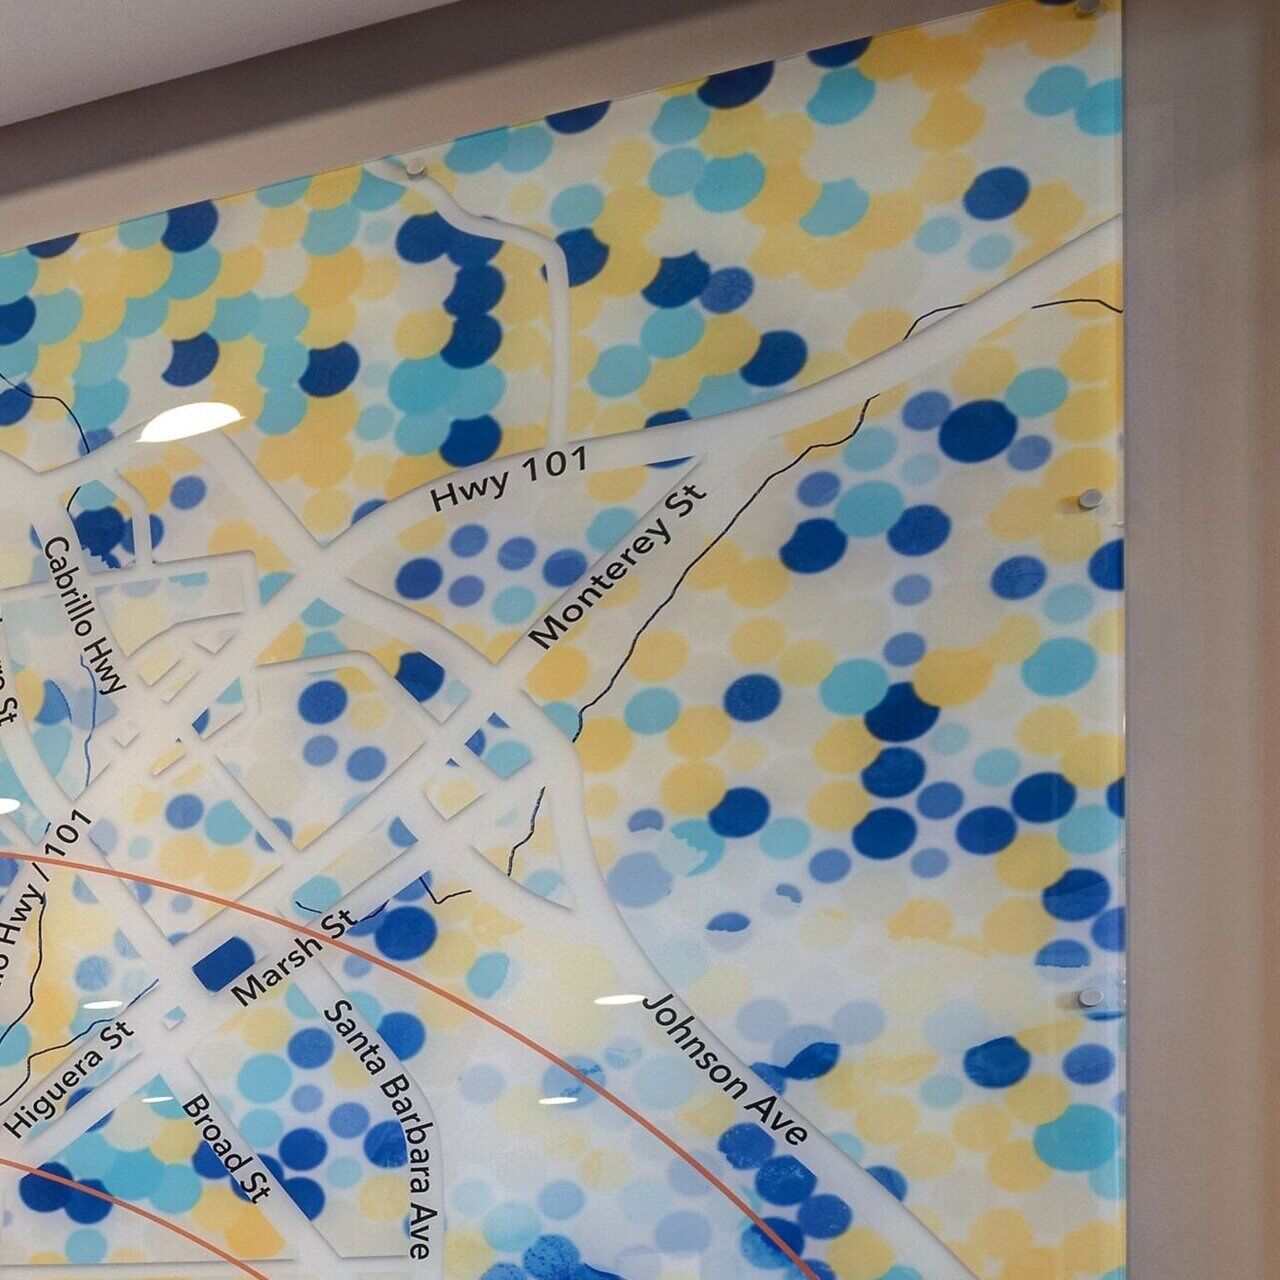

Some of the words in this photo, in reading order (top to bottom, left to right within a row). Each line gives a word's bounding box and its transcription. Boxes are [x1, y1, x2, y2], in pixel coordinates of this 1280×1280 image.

[430, 468, 510, 513] Hwy
[522, 444, 589, 482] 101
[44, 534, 95, 638] Cabrillo
[84, 634, 126, 697] Hwy
[528, 514, 671, 650] Monterey
[665, 482, 708, 521] St
[44, 808, 92, 857] 101
[230, 937, 323, 1006] Marsh
[316, 905, 359, 945] St
[2, 1048, 103, 1142] Higuera
[98, 1017, 134, 1051] St
[323, 999, 388, 1079] Santa
[378, 1073, 433, 1195] Barbara
[410, 1202, 431, 1262] Ave
[640, 992, 749, 1100] Johnson
[745, 1091, 810, 1148] Ave
[182, 1093, 254, 1173] Broad
[240, 1171, 271, 1204] St
